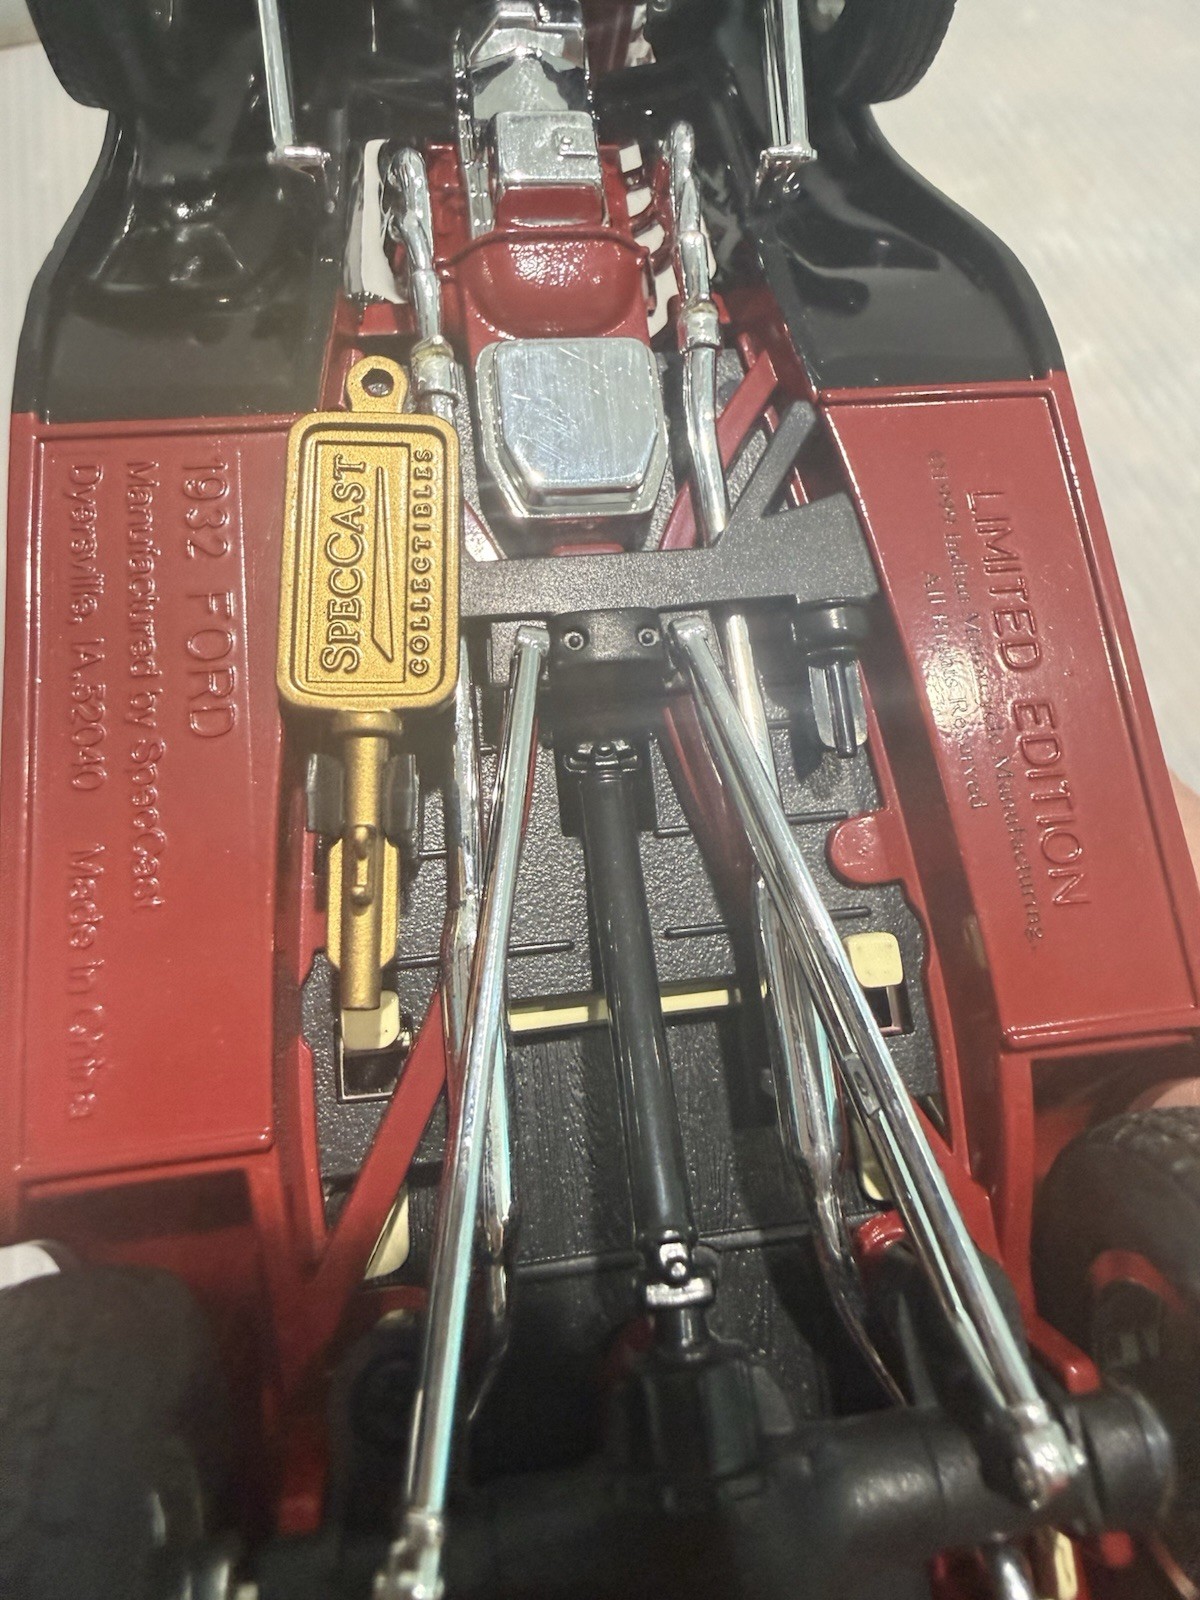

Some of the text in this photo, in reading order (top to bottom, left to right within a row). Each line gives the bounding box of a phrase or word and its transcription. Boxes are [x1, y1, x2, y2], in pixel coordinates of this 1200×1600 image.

[182, 463, 237, 738] 1932 FORD
[321, 454, 366, 673] SPECCAST
[410, 449, 433, 675] COLLECTIBLES
[922, 571, 947, 605] All
[125, 461, 167, 911] Manufactured by SpecCast
[966, 491, 1092, 906] LIMITED EDITION
[69, 843, 105, 949] Made
